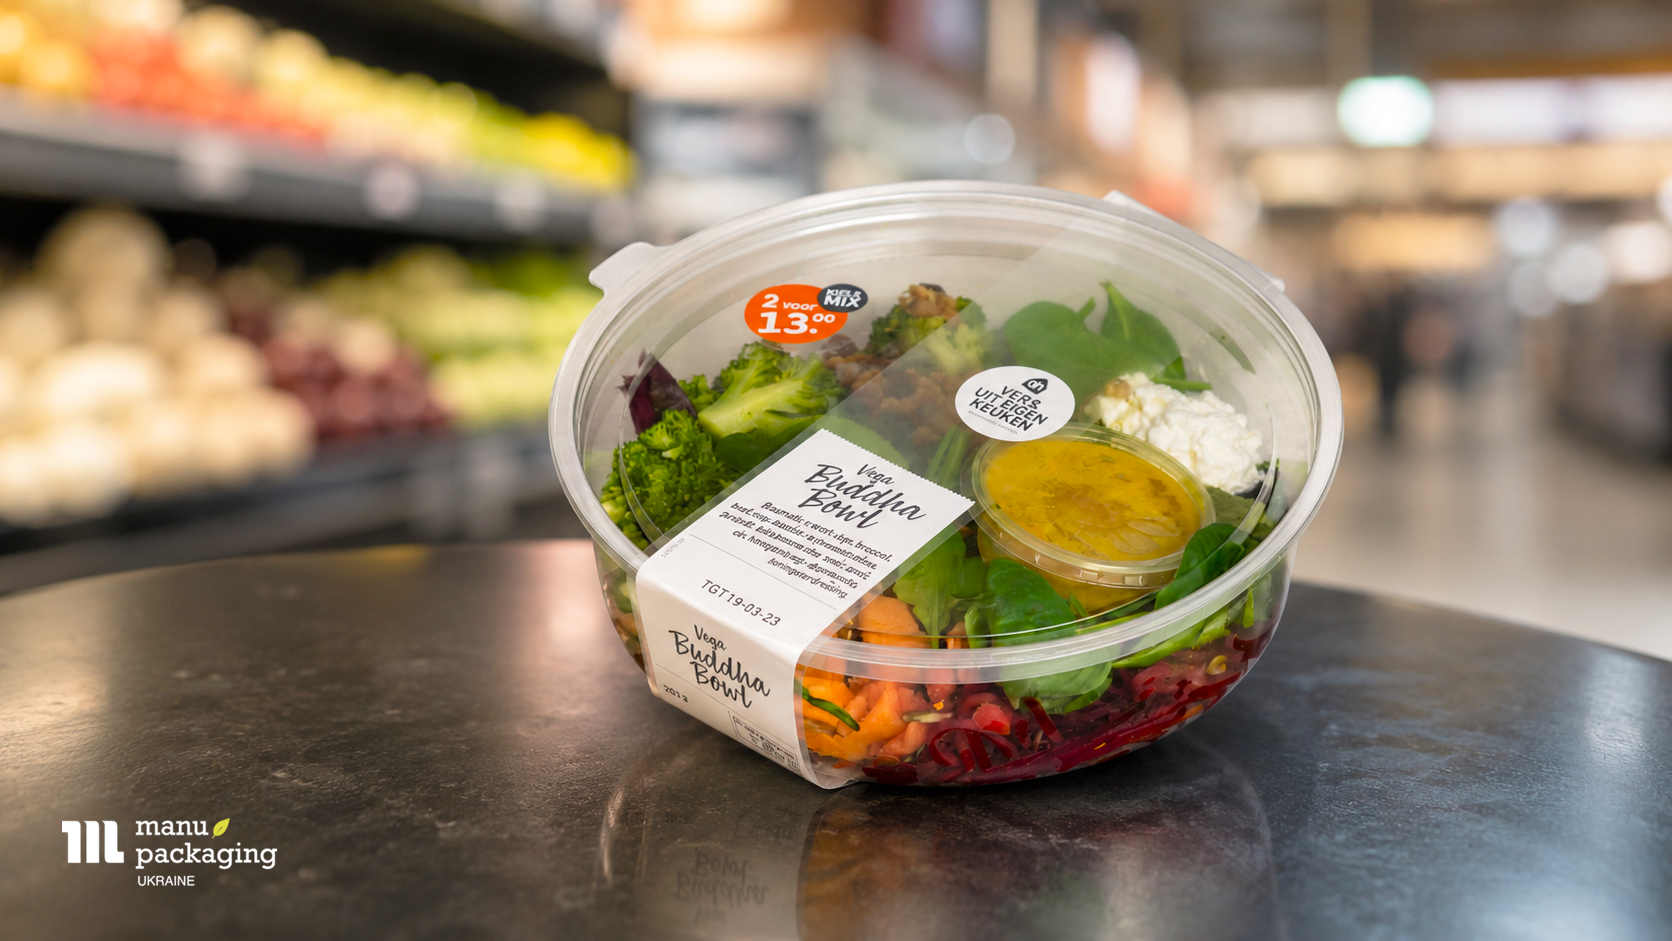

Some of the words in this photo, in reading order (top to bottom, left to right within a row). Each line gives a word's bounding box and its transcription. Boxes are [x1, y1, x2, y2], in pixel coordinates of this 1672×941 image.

[761, 293, 780, 309] 2
[782, 302, 818, 311] voor
[823, 295, 862, 308] MIX
[969, 398, 1033, 431] KEUKEN
[975, 387, 1003, 403] UIT
[999, 399, 1048, 425] EIGEN
[1001, 385, 1041, 410] VERS
[857, 463, 894, 485] Vega
[797, 488, 883, 529] Bowl
[804, 464, 926, 521] Buddha
[701, 579, 730, 598] TGT
[726, 593, 782, 627] 19-03-23
[694, 624, 727, 651] Vega
[668, 630, 771, 697] Buddha
[689, 661, 752, 708] Bowl
